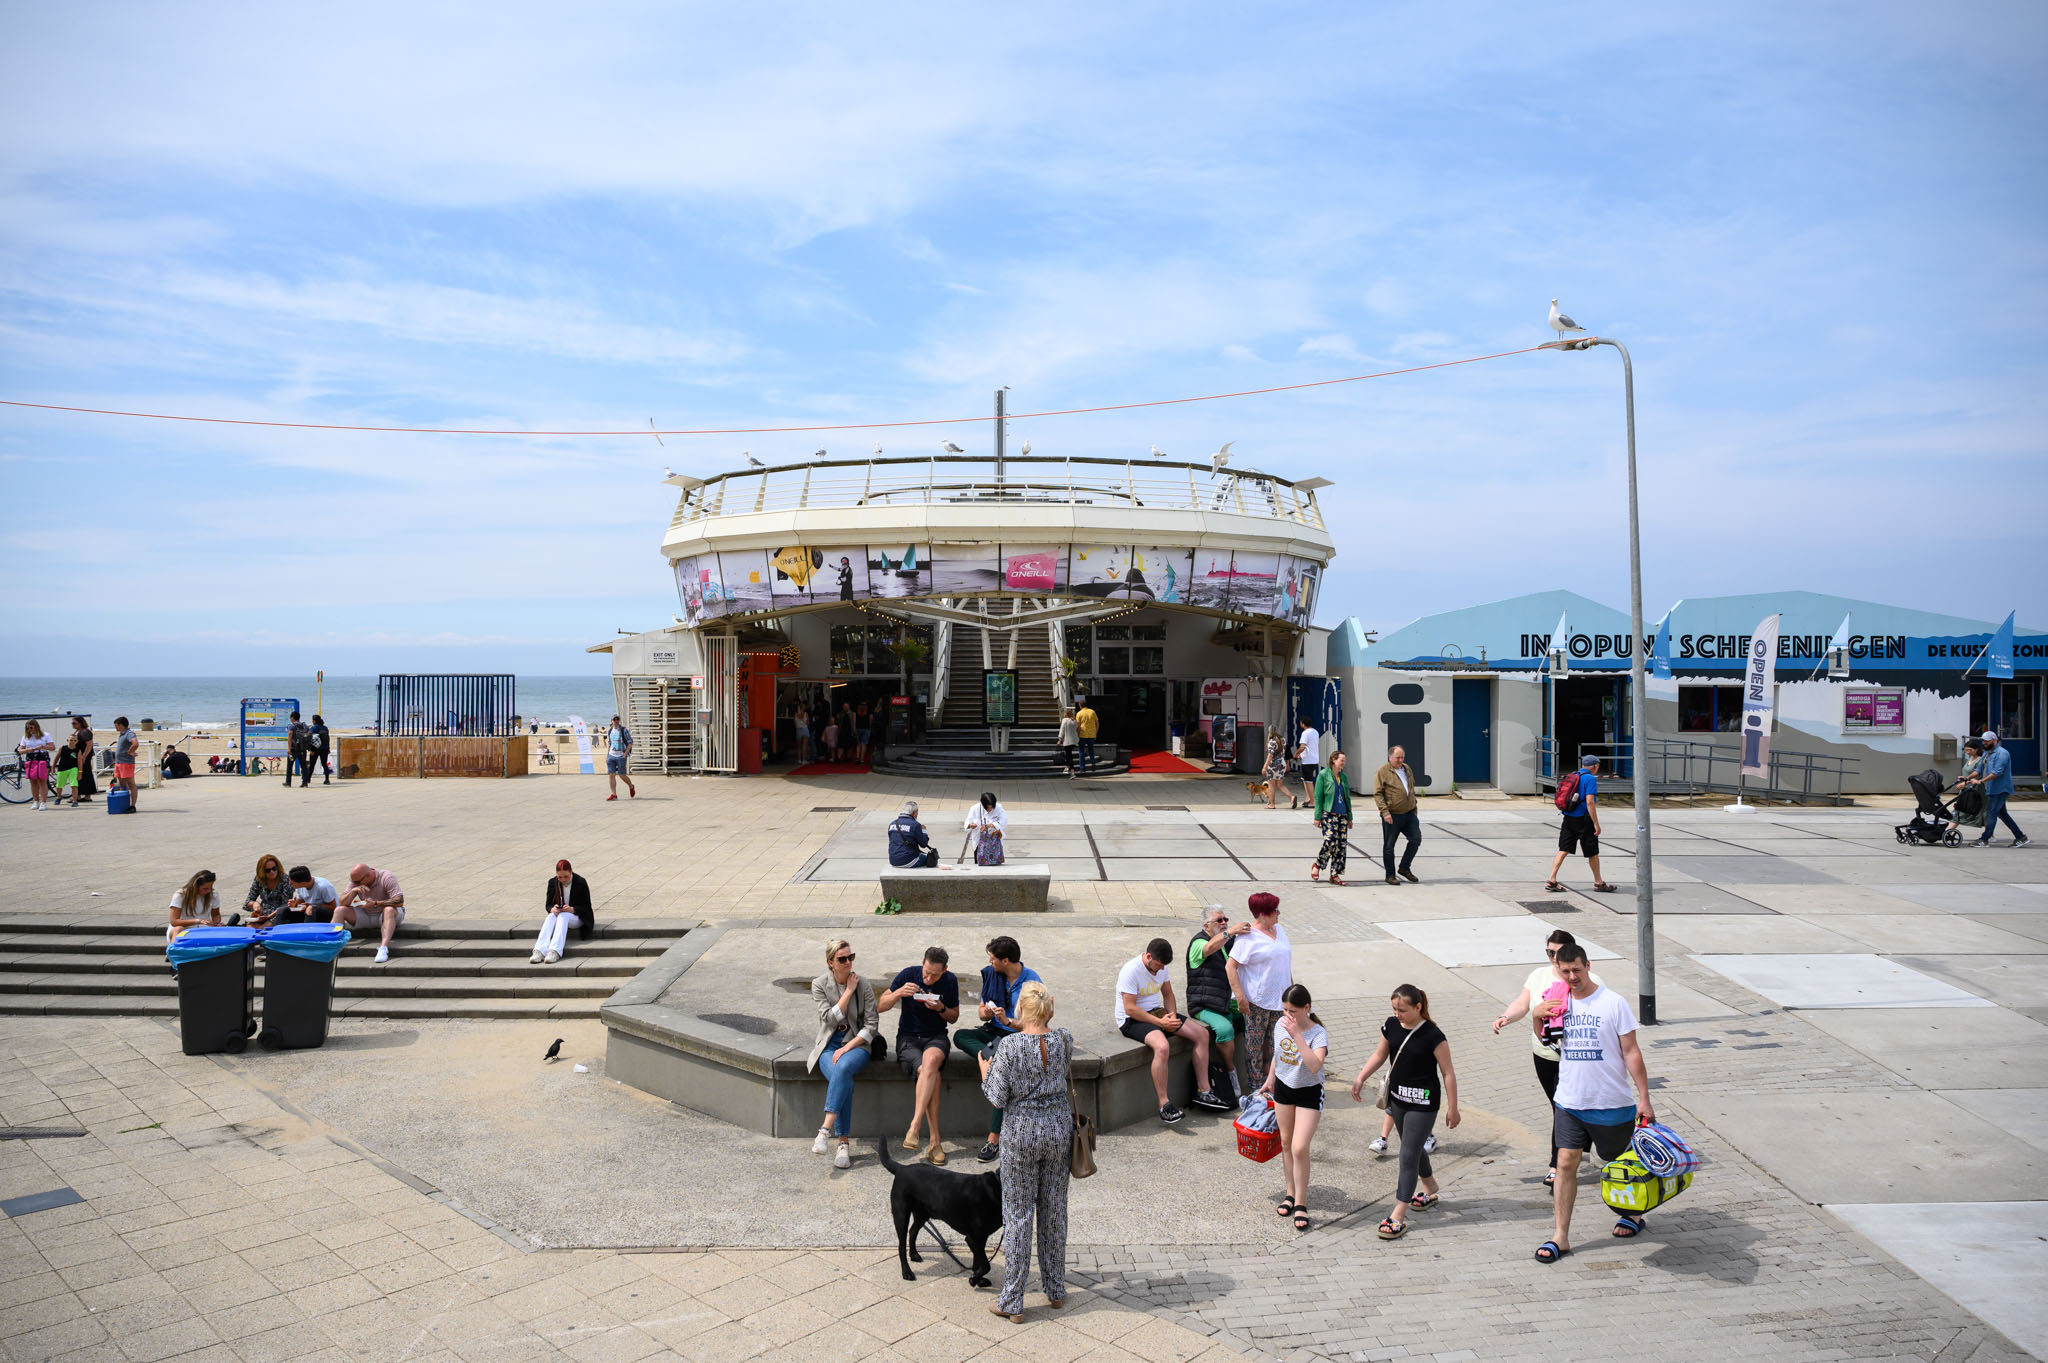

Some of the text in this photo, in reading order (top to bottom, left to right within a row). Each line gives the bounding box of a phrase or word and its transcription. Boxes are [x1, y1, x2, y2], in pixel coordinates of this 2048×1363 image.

[1680, 634, 1906, 659] SCHEENIGEN
[1928, 645, 1947, 658] DE
[1749, 639, 1767, 701] OPEN
[1564, 1028, 1598, 1040] MNIE
